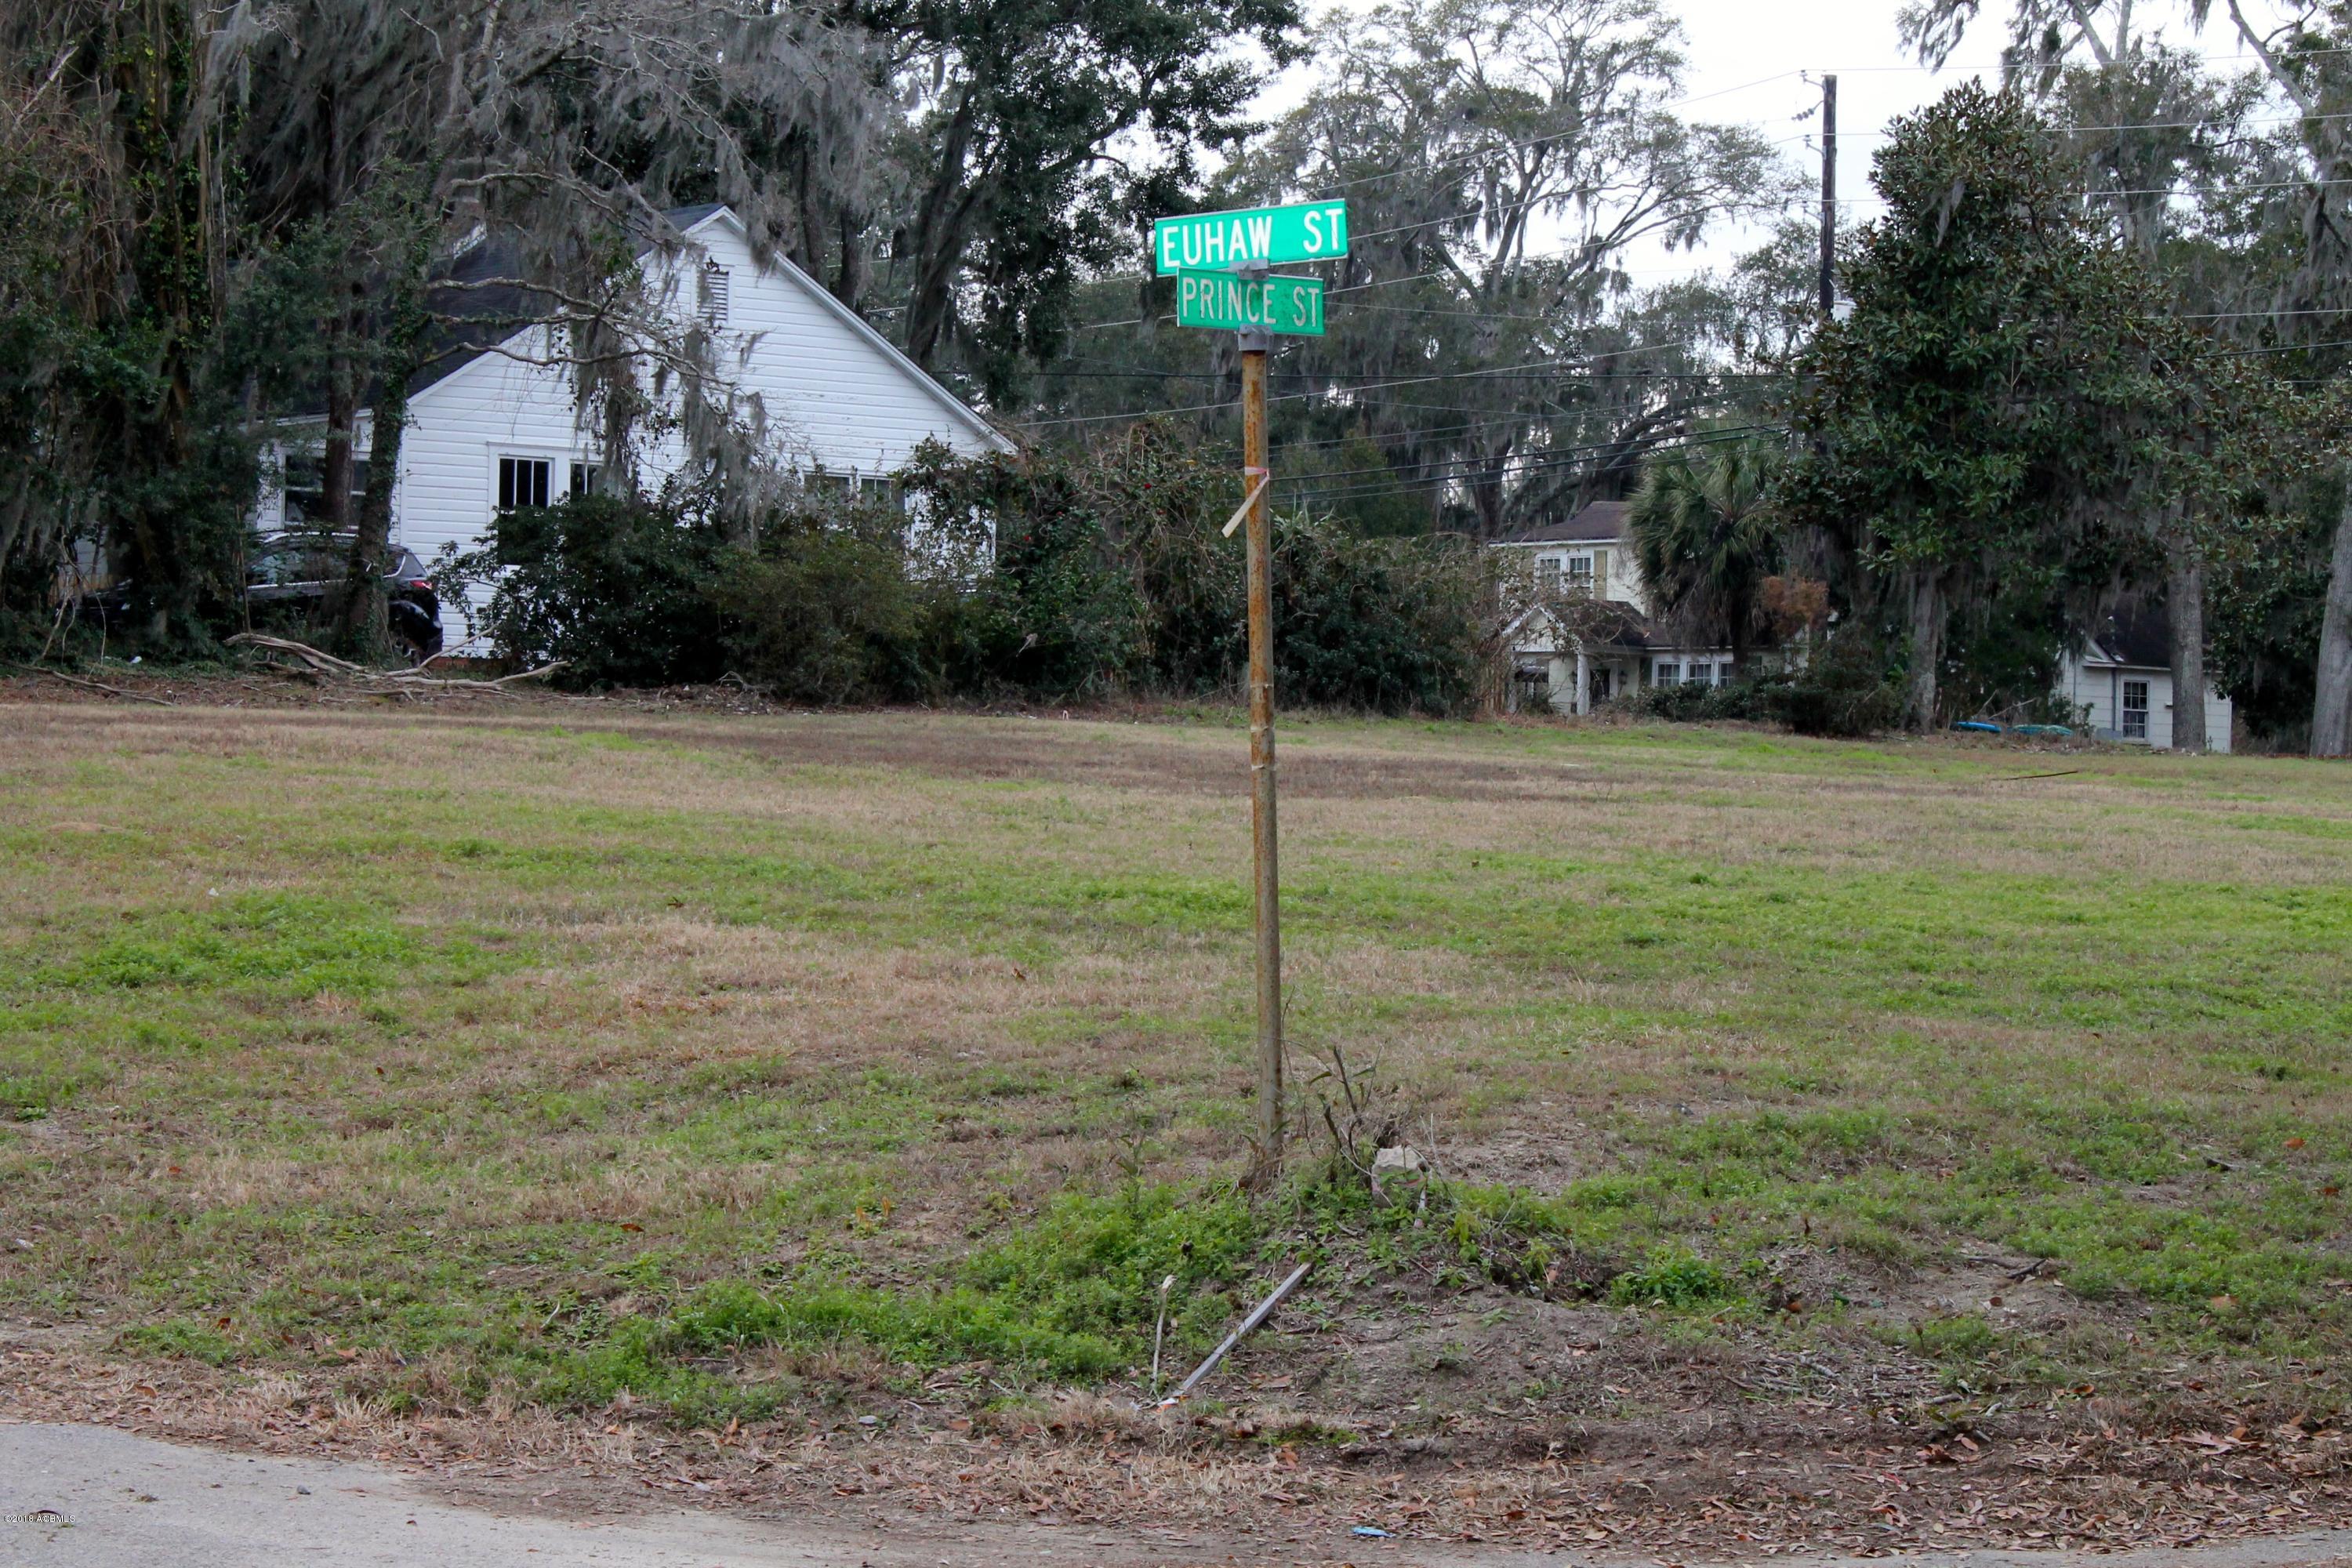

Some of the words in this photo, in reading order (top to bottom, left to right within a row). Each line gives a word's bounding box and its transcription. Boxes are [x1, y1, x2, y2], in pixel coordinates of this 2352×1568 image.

[1163, 216, 1272, 267] EUHAW
[1303, 209, 1343, 253] ST
[1182, 278, 1276, 325] PRINCE
[1293, 286, 1319, 327] ST
